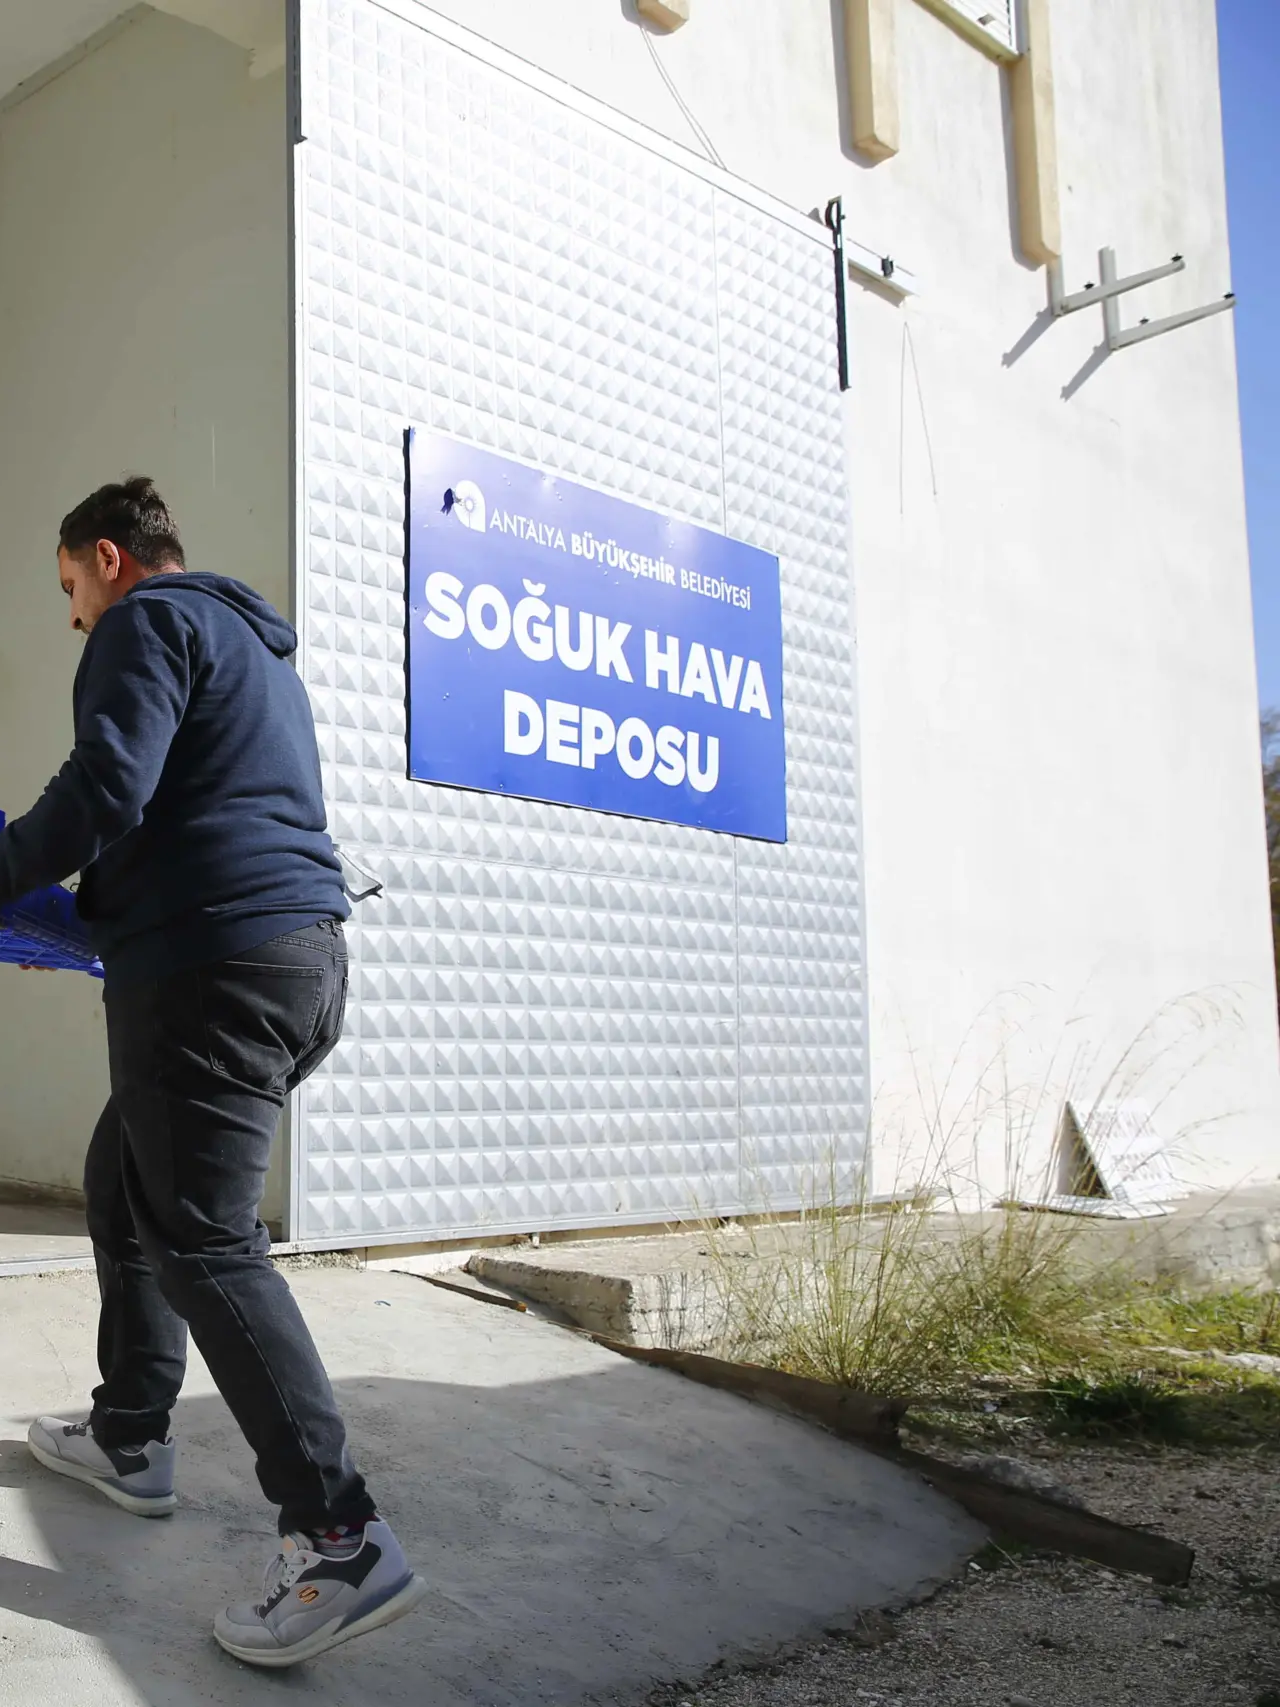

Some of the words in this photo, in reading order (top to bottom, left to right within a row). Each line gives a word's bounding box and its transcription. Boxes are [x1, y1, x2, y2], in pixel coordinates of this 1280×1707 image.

[489, 507, 567, 552] ANTALYA
[571, 530, 676, 586] BÜYÜKŞEHİR
[680, 568, 751, 611] BELEDİYESİ
[422, 570, 634, 684] SOĞUK
[644, 629, 772, 720] HAVA
[503, 689, 721, 793] DEPOSU
